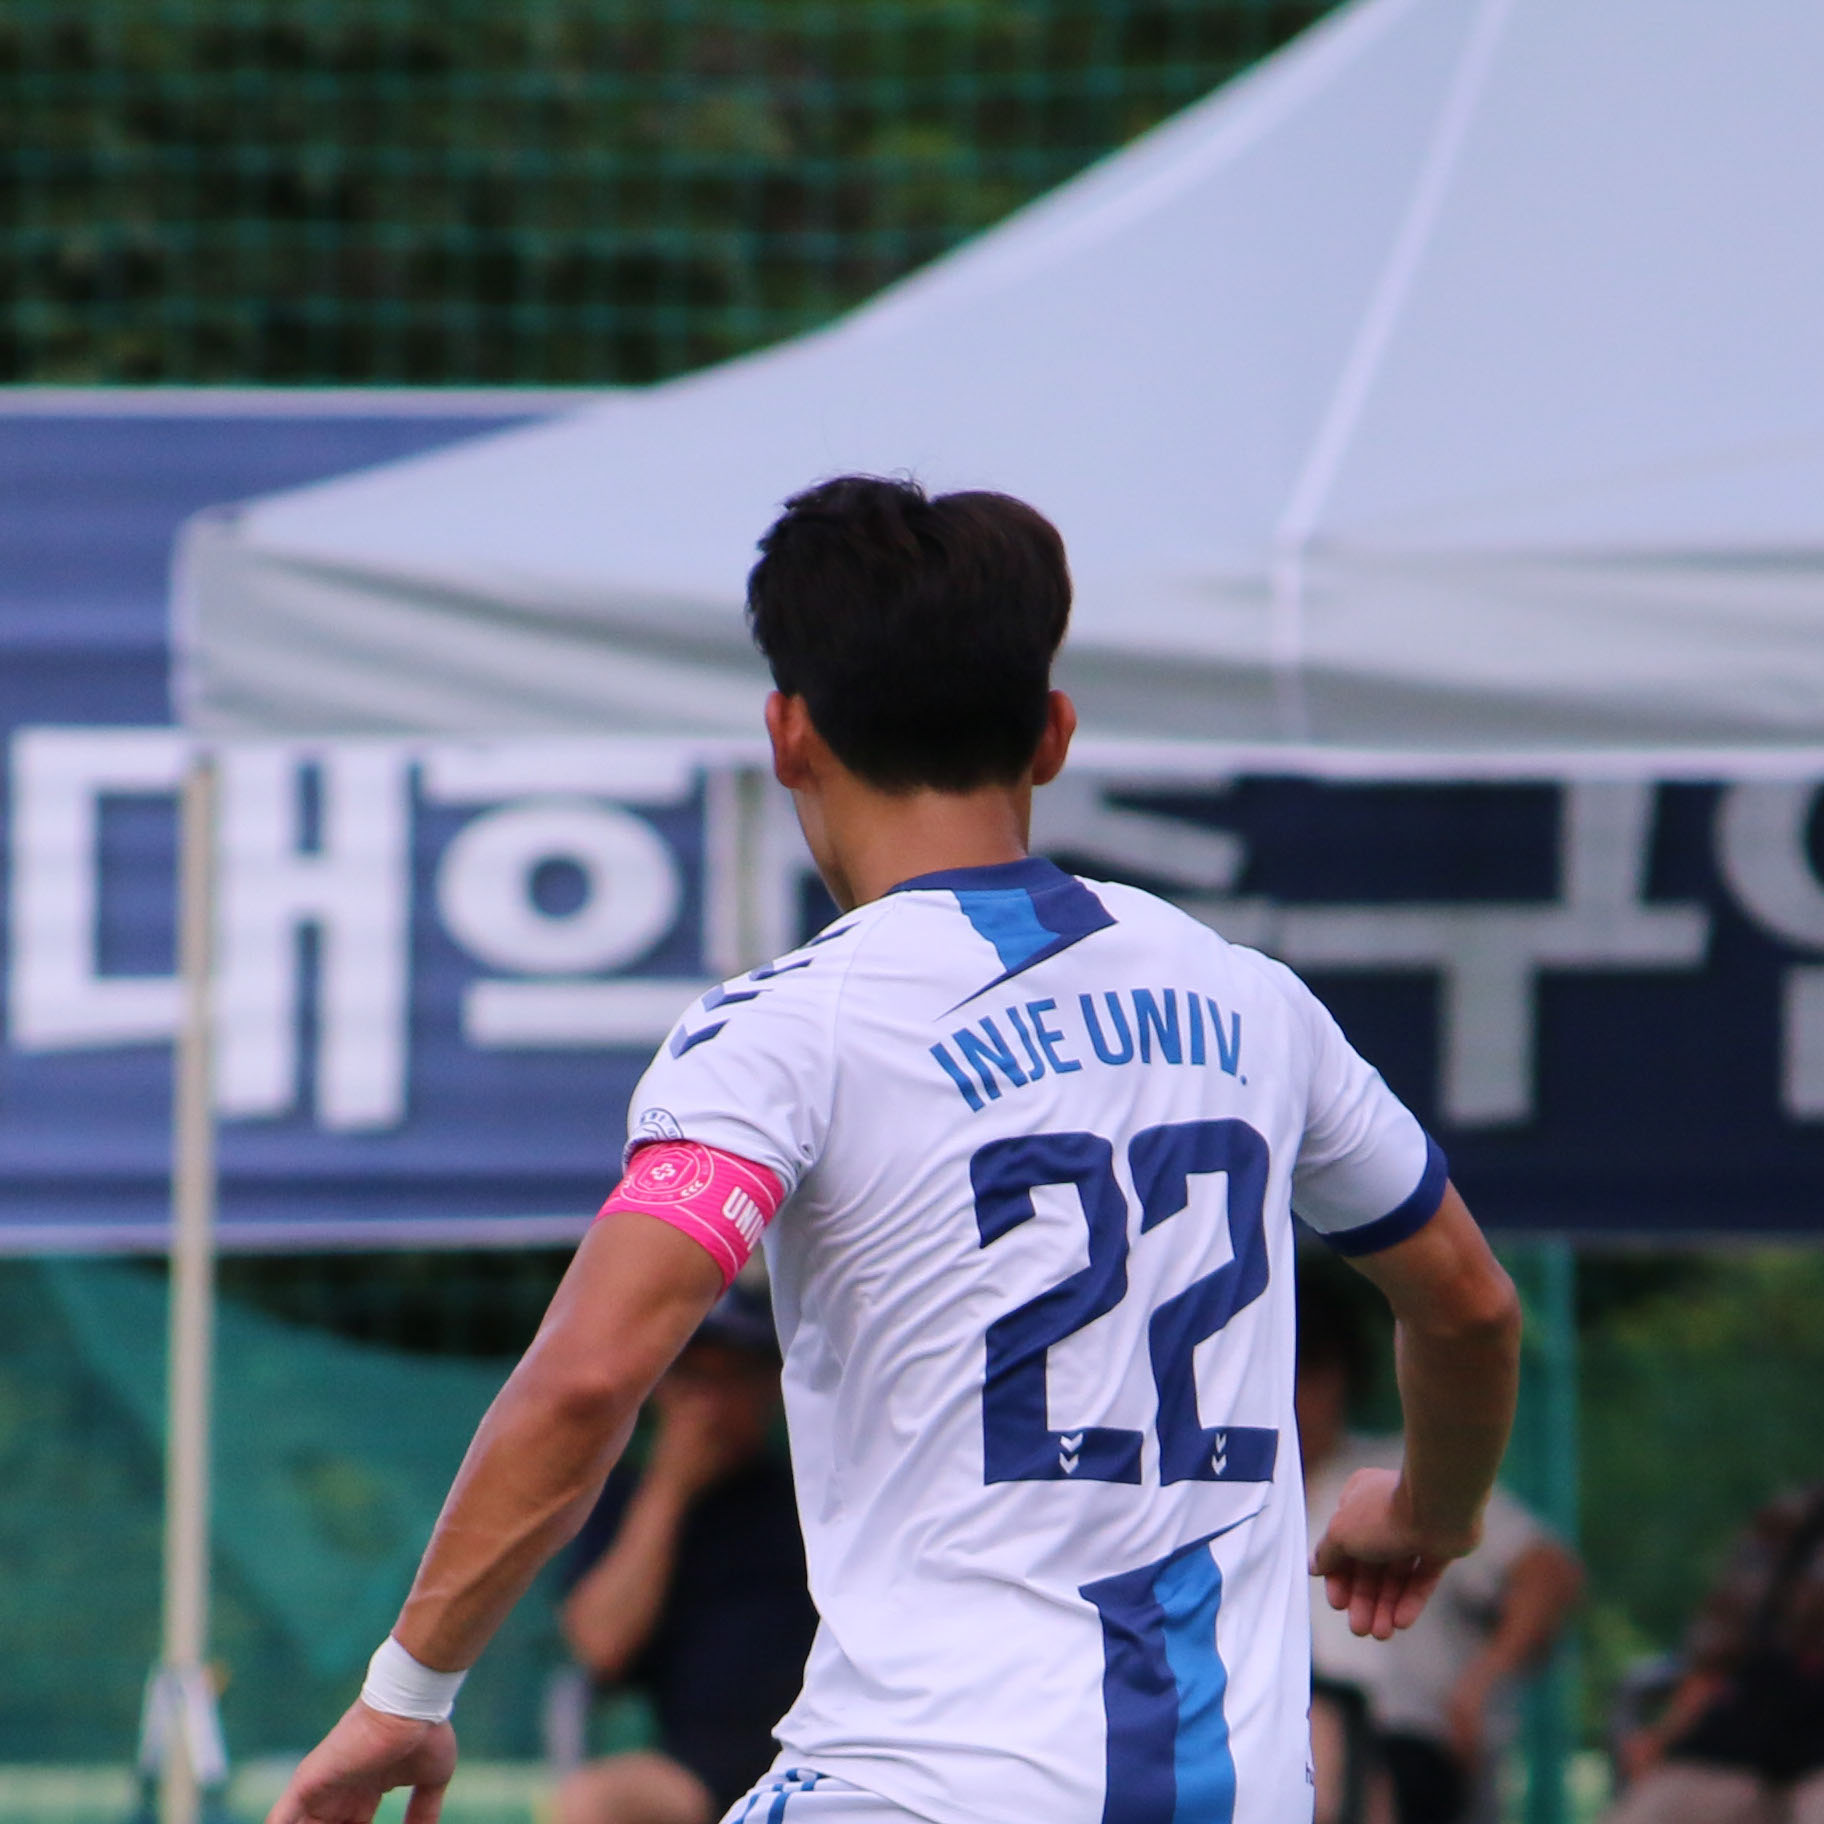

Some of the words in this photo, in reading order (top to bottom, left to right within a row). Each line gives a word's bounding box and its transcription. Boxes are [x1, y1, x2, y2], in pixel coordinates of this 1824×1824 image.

[929, 999, 1081, 1113] INJE
[1078, 988, 1247, 1086] UNIV.
[969, 1117, 1279, 1488] 22
